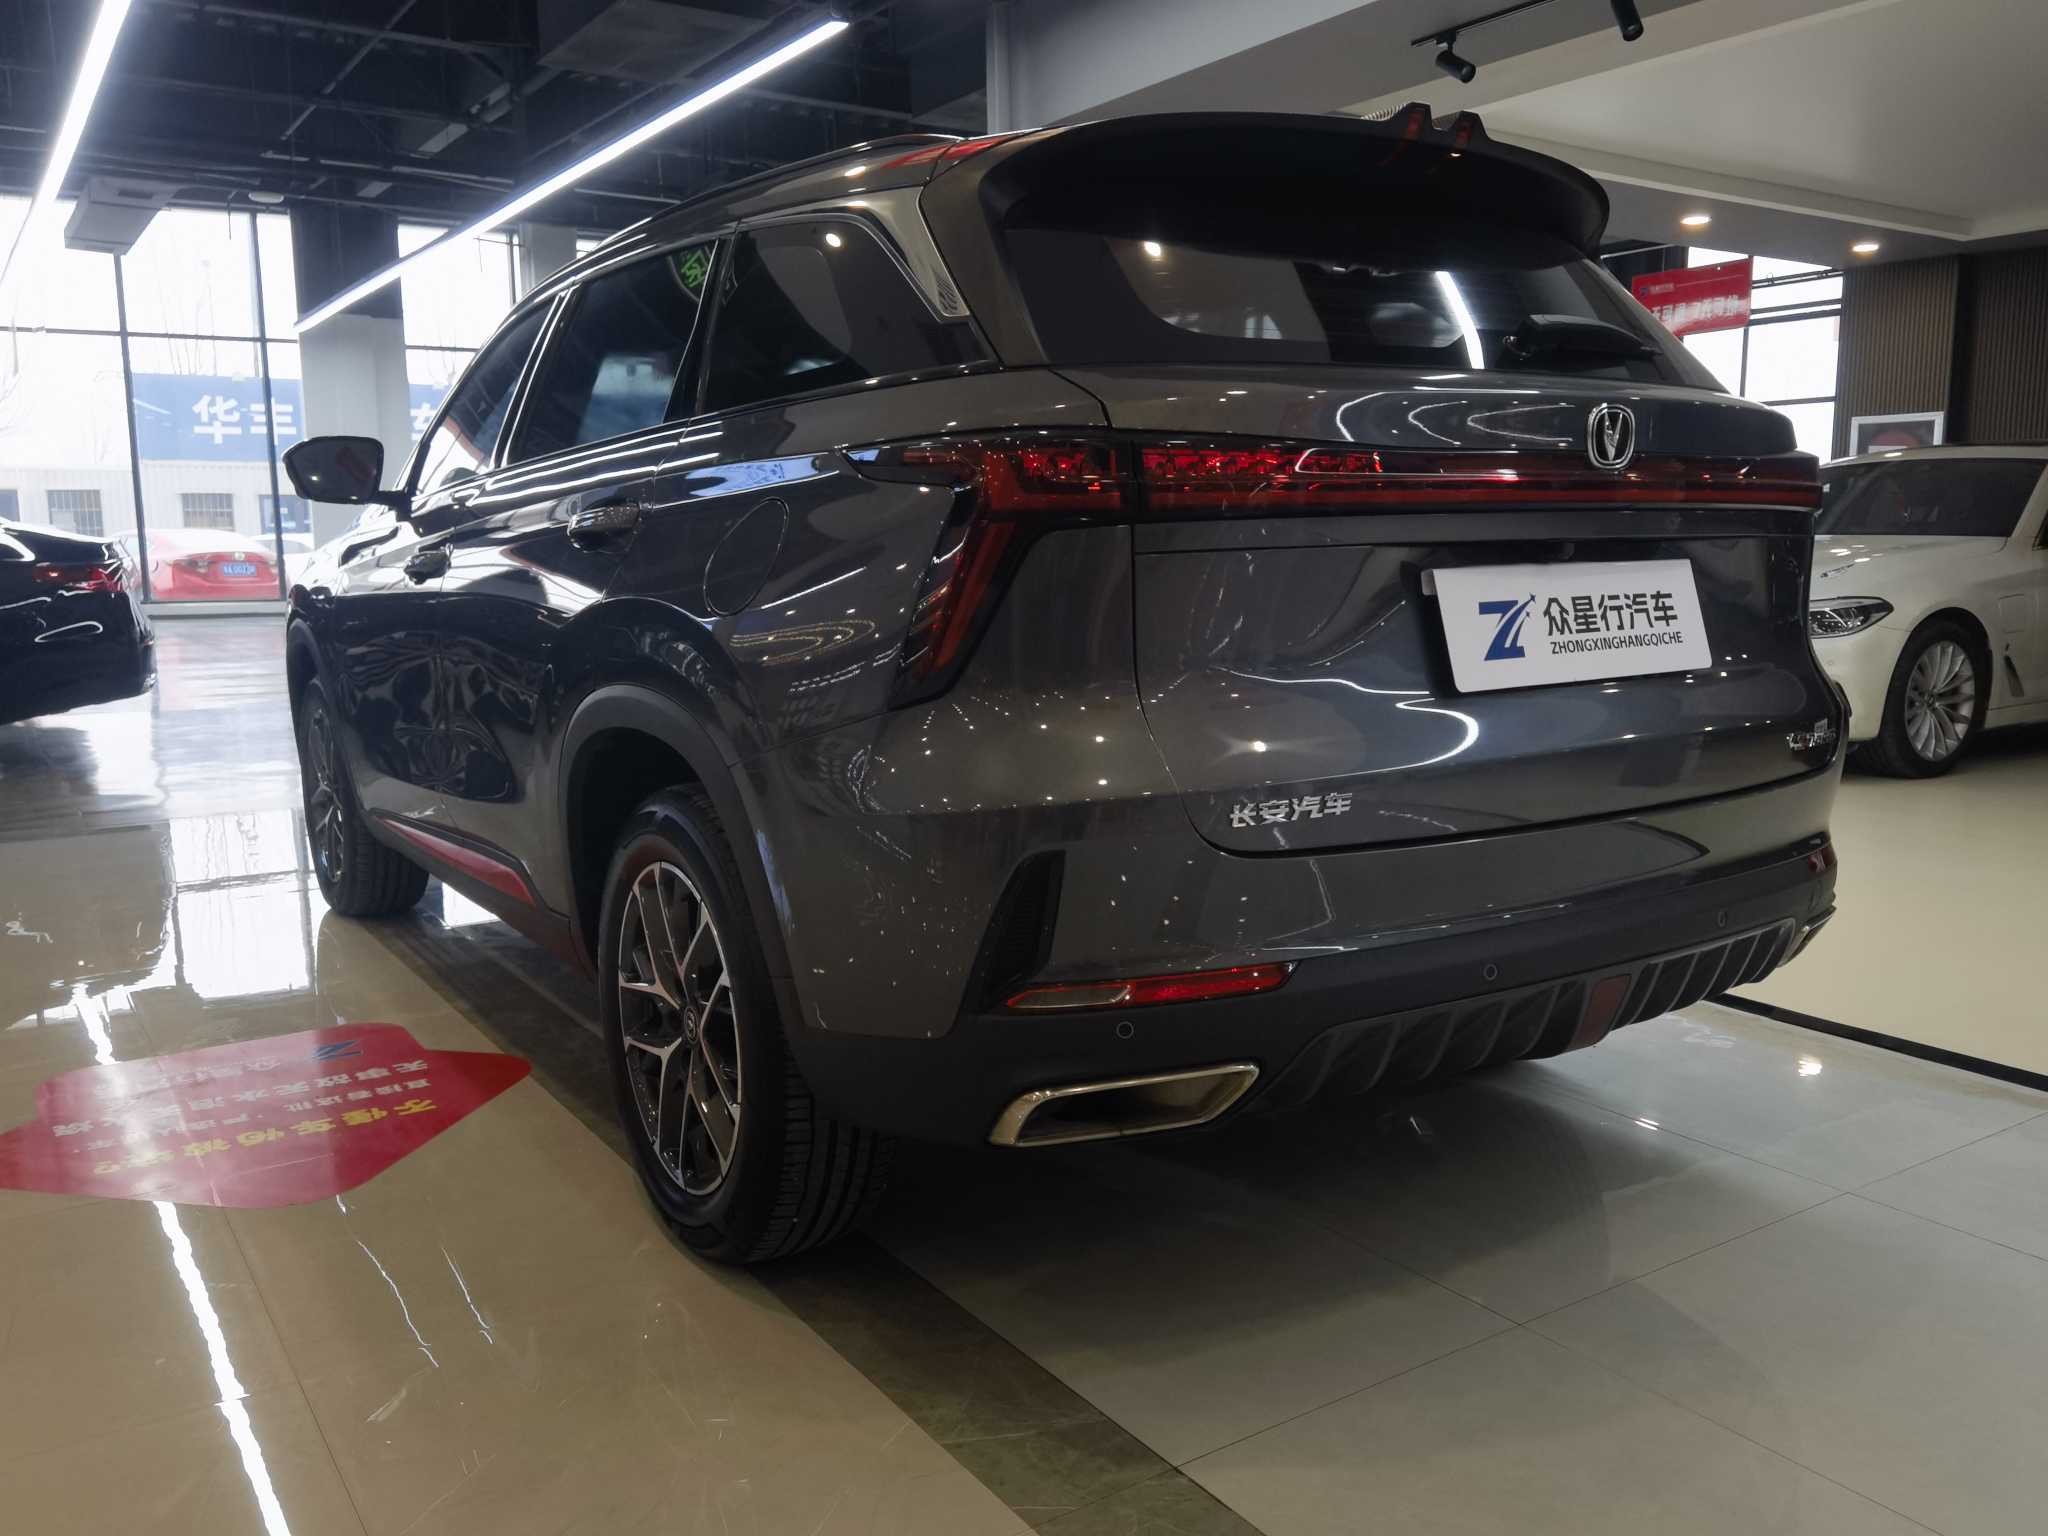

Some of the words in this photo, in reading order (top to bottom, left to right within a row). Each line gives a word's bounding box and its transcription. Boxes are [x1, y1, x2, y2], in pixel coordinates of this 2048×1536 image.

[192, 395, 297, 445] 华丰
[1543, 591, 1678, 636] 众星行汽车
[1550, 631, 1684, 655] ZHONGXINGHANGQICHE
[1229, 792, 1353, 828] 长安汽车
